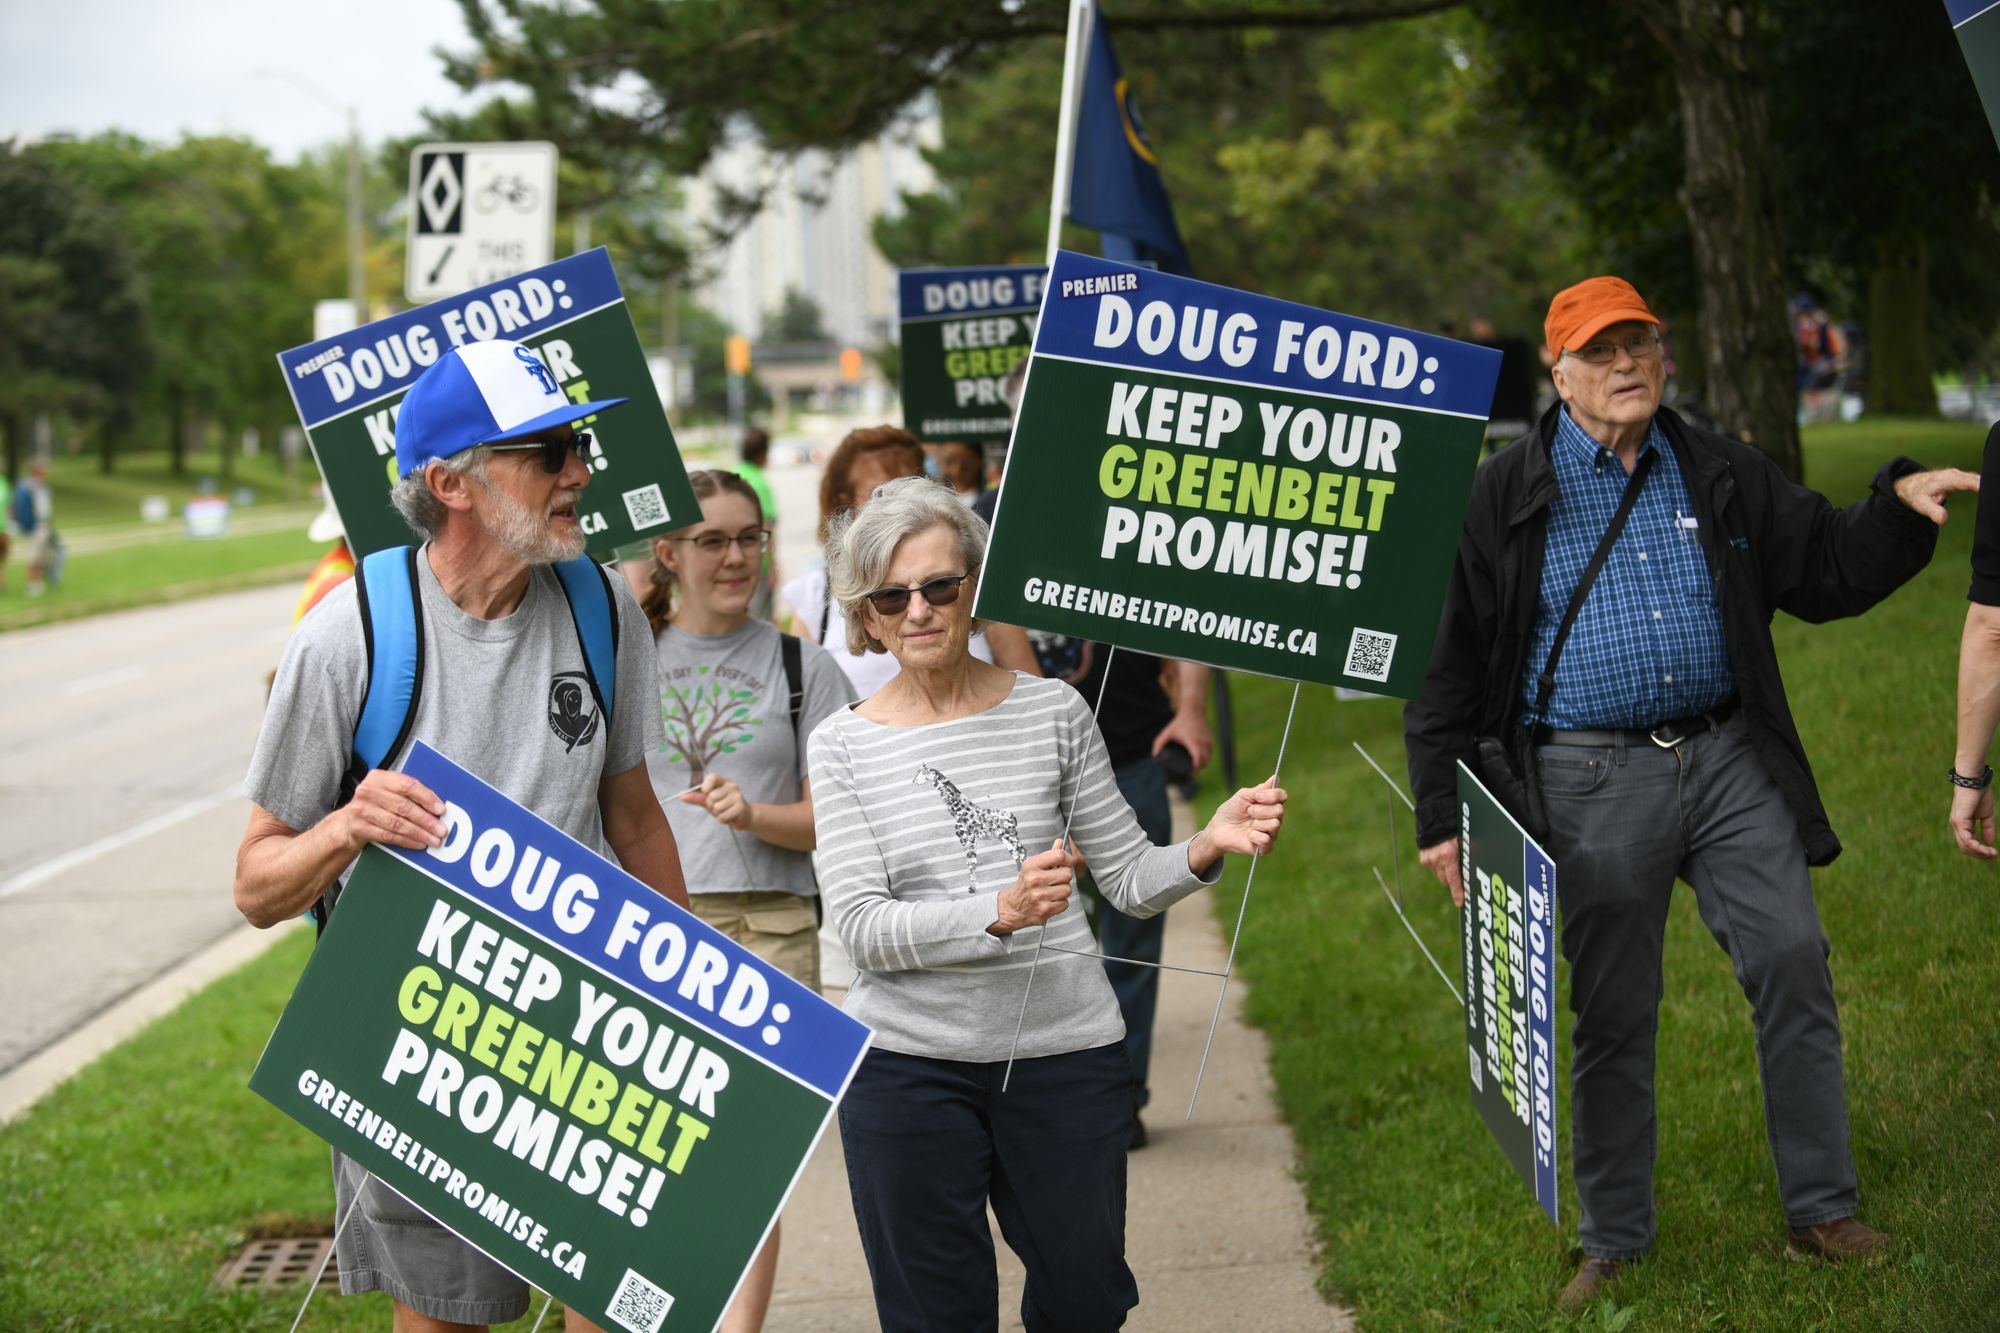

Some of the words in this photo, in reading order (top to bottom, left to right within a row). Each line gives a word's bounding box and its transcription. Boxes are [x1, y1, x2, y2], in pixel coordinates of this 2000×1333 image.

[323, 324, 439, 403] DOUG
[441, 278, 574, 349] FORD:
[923, 276, 1015, 313] DOUG
[941, 317, 1018, 350] KEEP
[1062, 272, 1138, 298] PREMIER
[295, 345, 346, 379] PREMIER
[1093, 294, 1258, 369] DOUG
[1273, 319, 1439, 396] FORD:
[1106, 381, 1243, 451] KEEP
[1258, 401, 1402, 474] YOUR
[1098, 443, 1396, 533] GREENBELT
[1100, 506, 1369, 591] PROMISE!
[1023, 577, 1318, 657] GREENBELTPROMISE.CA
[426, 800, 600, 935] DOUG
[604, 899, 791, 1046] FORD:
[1462, 801, 1477, 1030] GREENBELTPROMISE.CA
[1507, 884, 1525, 999] KEEP
[1529, 885, 1547, 1023] DOUG
[1540, 864, 1551, 927] PREMIER
[416, 899, 563, 1013] KEEP
[570, 980, 731, 1119] YOUR
[1476, 866, 1502, 1084] PROMISE!
[1491, 873, 1516, 1114] GREENBELT
[397, 964, 710, 1175] GREENBELT
[1511, 1008, 1531, 1126] YOUR
[1533, 1029, 1552, 1168] FORD:
[298, 1069, 588, 1281] GREENBELTPROMISE.CA
[380, 1027, 667, 1228] PROMISE!
